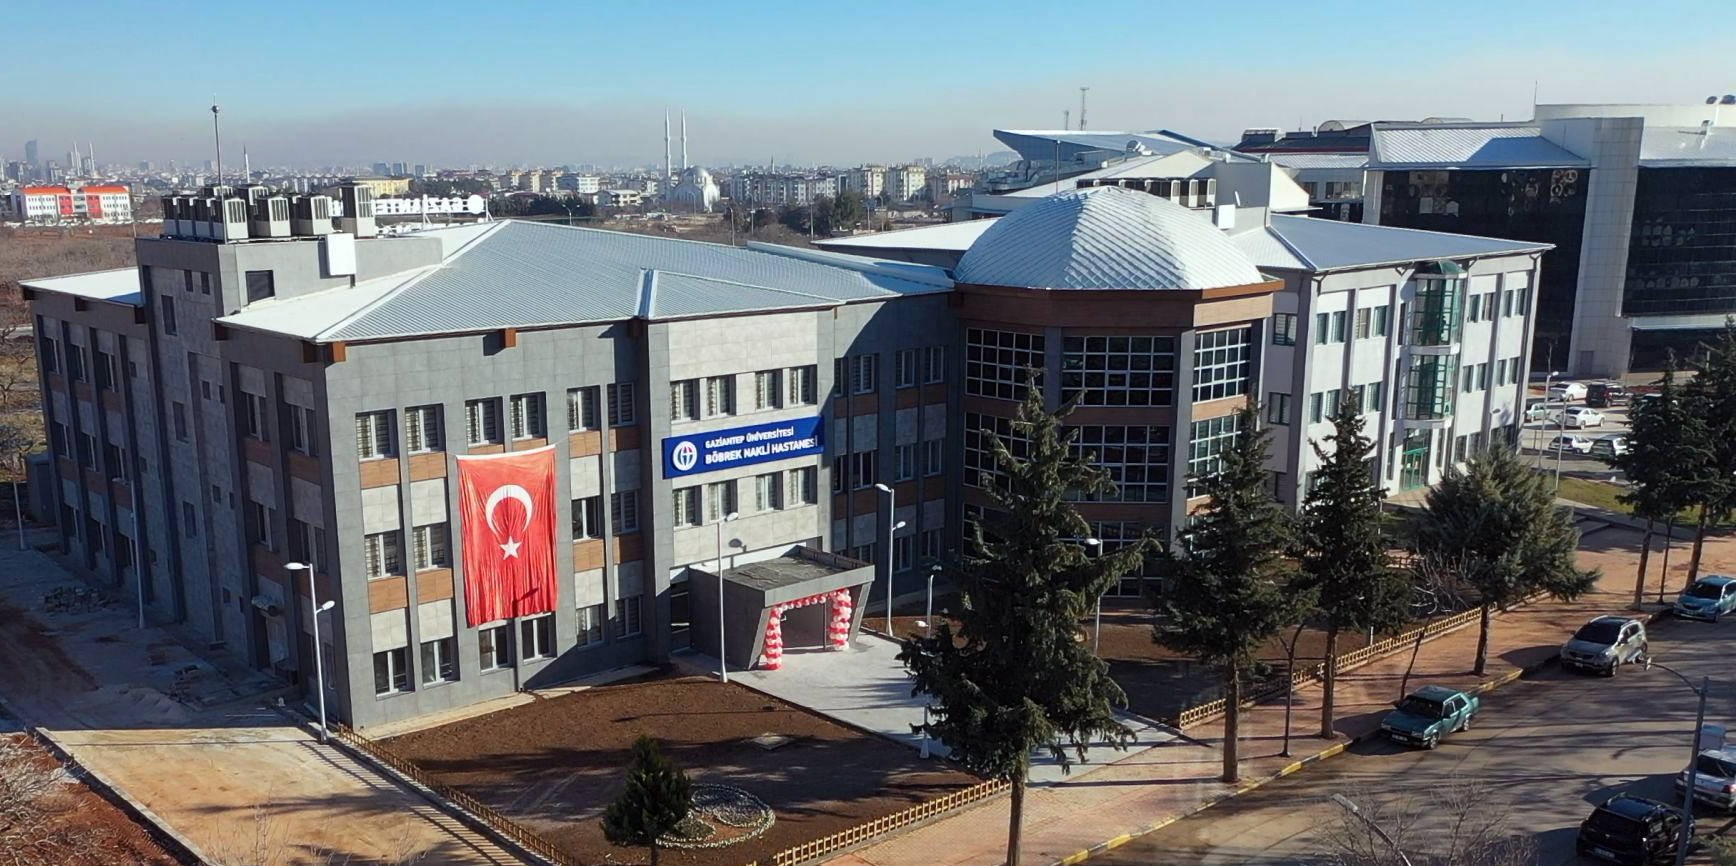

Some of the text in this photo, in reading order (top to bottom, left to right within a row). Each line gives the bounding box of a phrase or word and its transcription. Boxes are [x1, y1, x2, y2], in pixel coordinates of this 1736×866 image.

[705, 426, 794, 449] GAZİANTEP ÜNİVERSİTESİ
[705, 435, 818, 464] BÖBREK NAKLİ HASTANESİ
